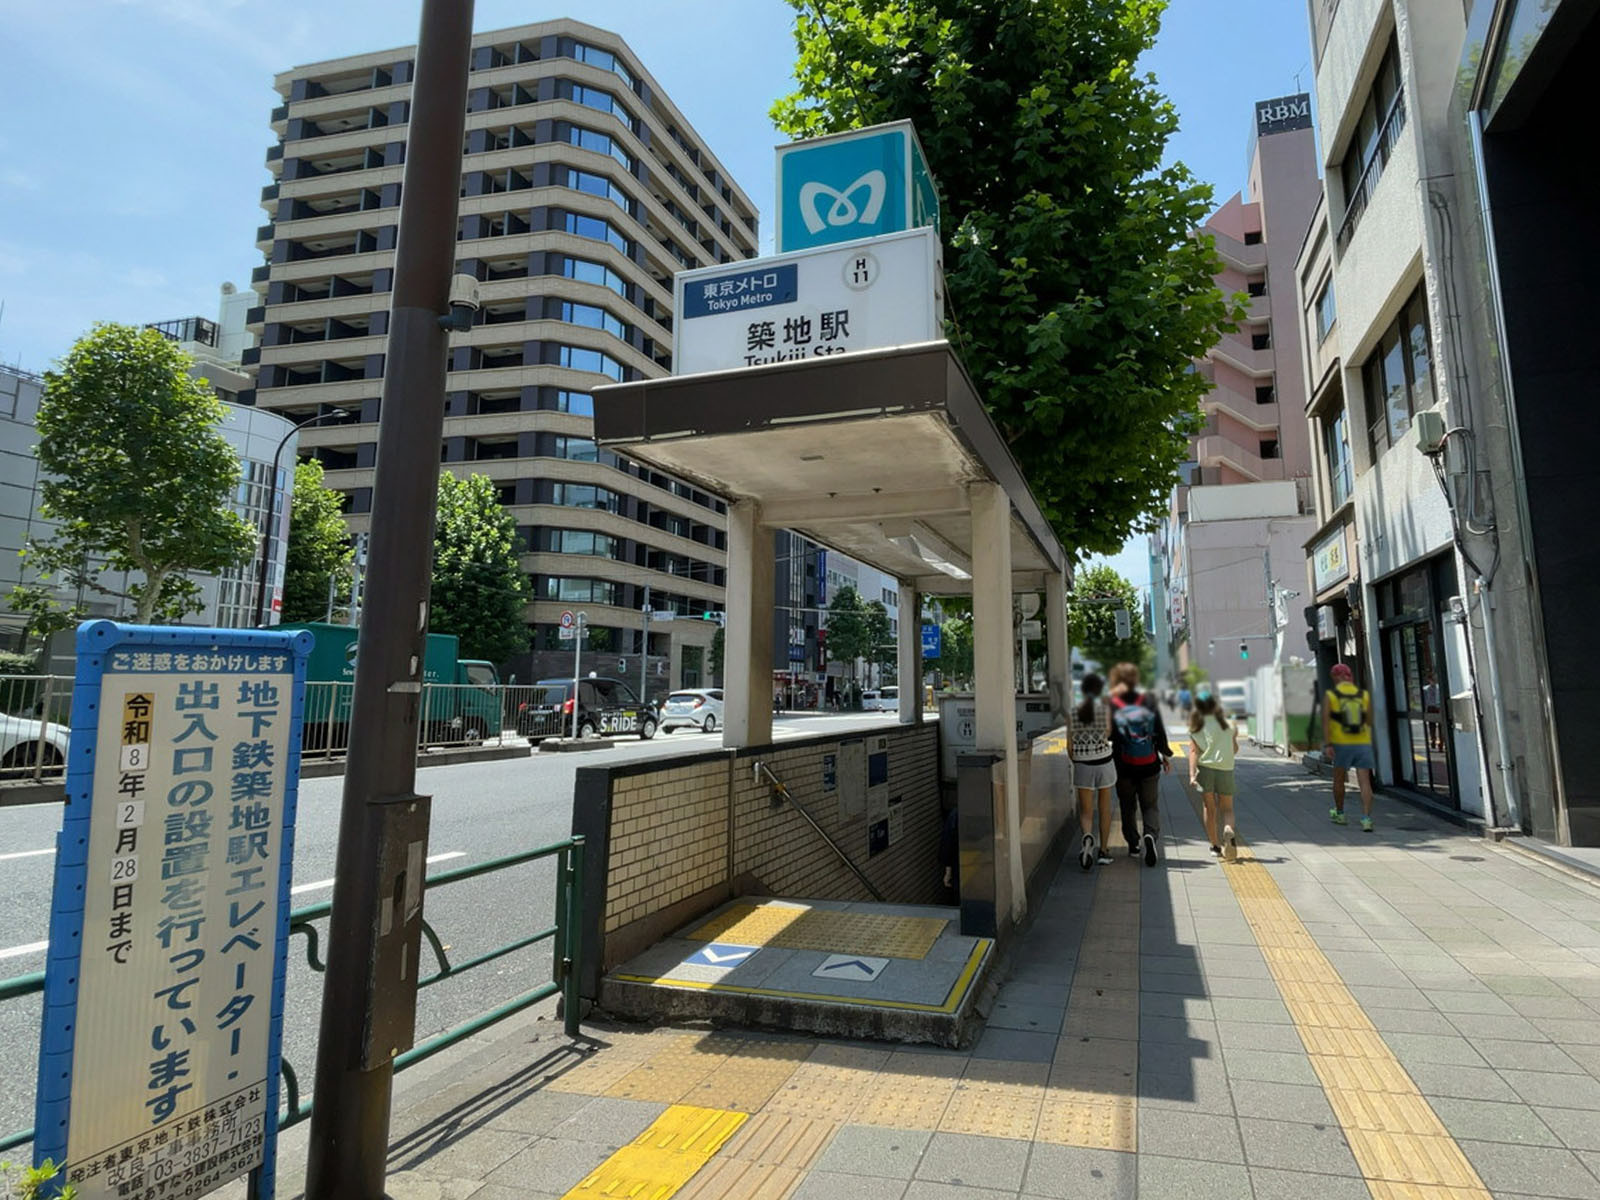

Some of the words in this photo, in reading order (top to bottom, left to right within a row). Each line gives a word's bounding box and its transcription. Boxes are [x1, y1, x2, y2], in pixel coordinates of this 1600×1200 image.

[1259, 101, 1309, 123] RBM
[855, 258, 866, 270] H
[703, 273, 777, 299] 東京メトロ
[852, 270, 869, 284] 11
[707, 295, 738, 311] Tokyo
[740, 291, 773, 305] Metro
[746, 310, 850, 350] 築地駅
[112, 652, 288, 672] ご迷惑をおかけします
[145, 680, 220, 1124] 出入口の設置を行っています
[154, 1118, 261, 1181] 03-3837-7123
[160, 1149, 261, 1200] 3-6264-3621
